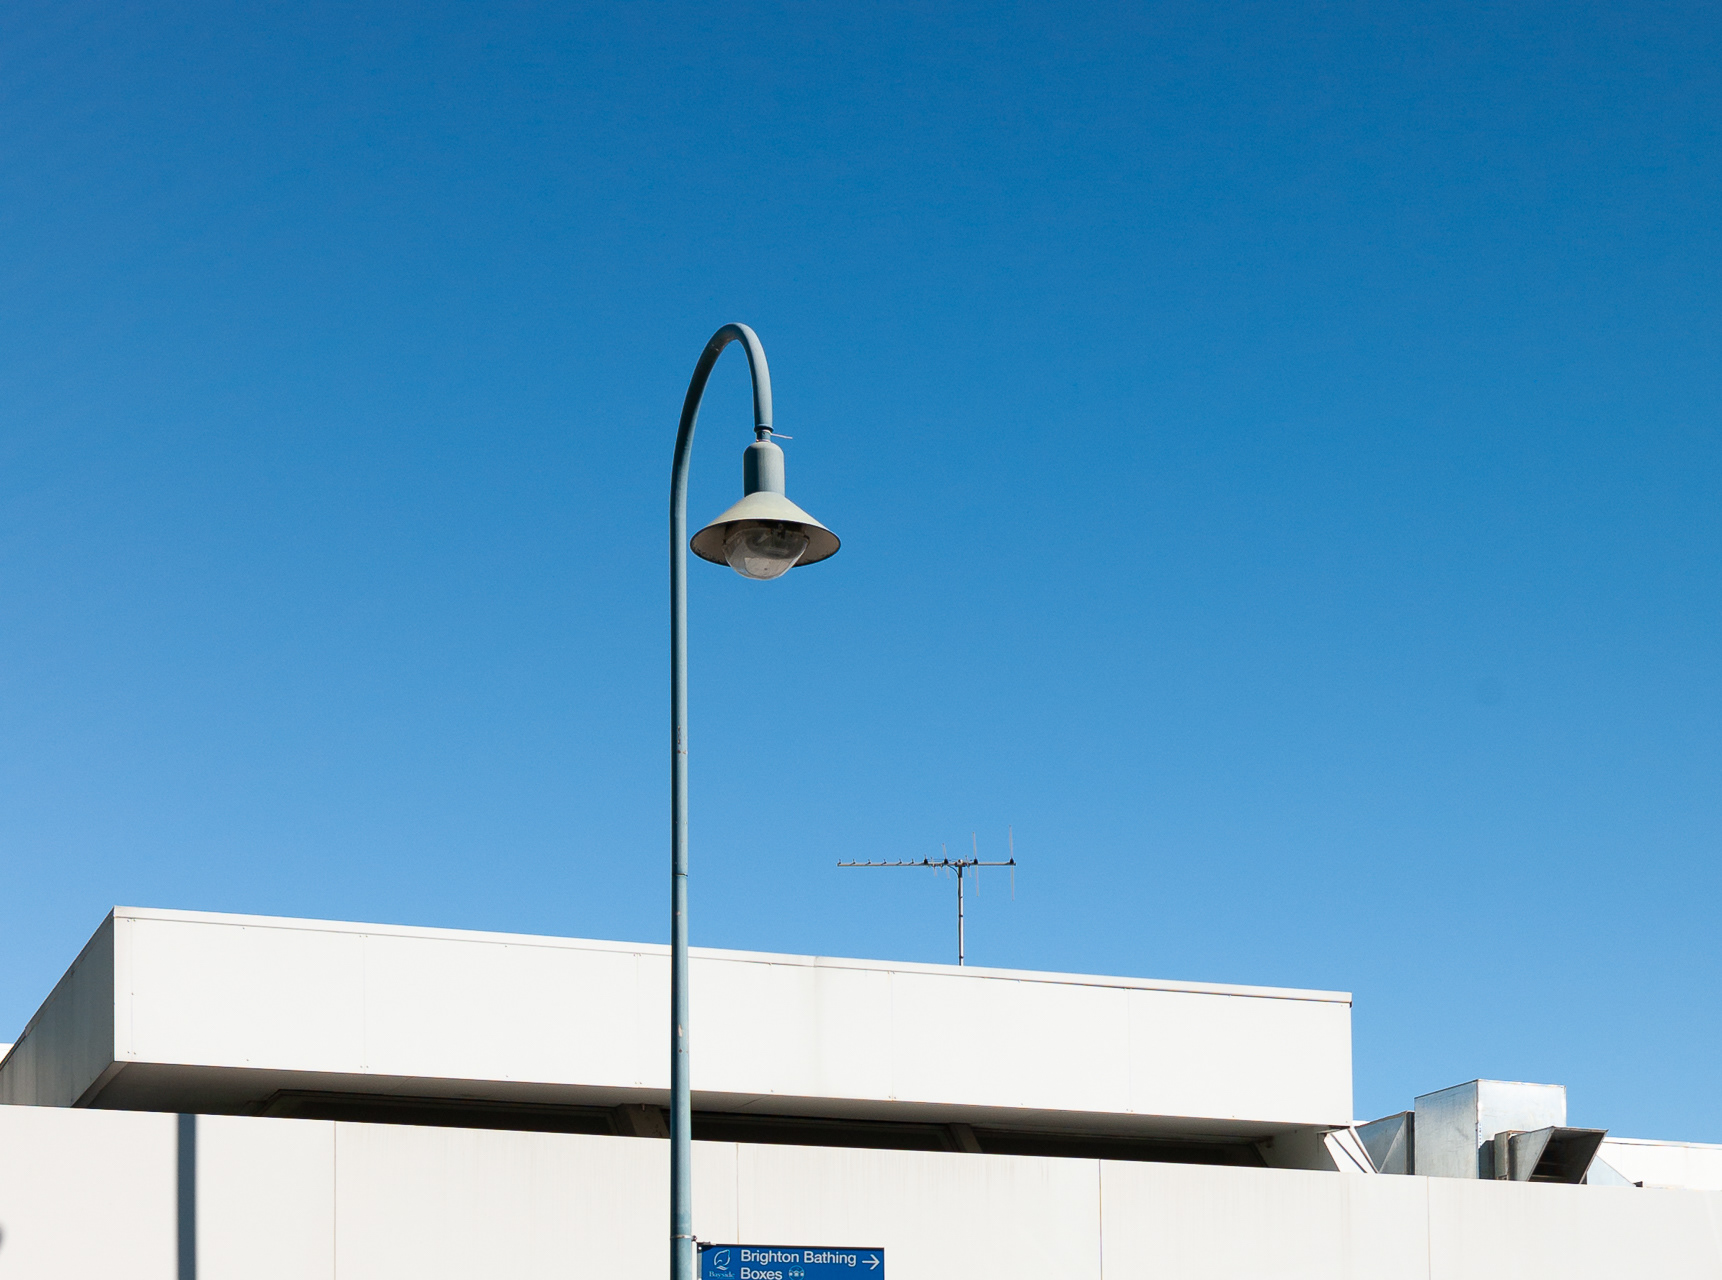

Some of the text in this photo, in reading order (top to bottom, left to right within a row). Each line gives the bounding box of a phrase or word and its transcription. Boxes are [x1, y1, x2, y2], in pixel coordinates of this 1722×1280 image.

[740, 1249, 857, 1267] Brighton Bathing
[740, 1267, 783, 1280] Boxes
